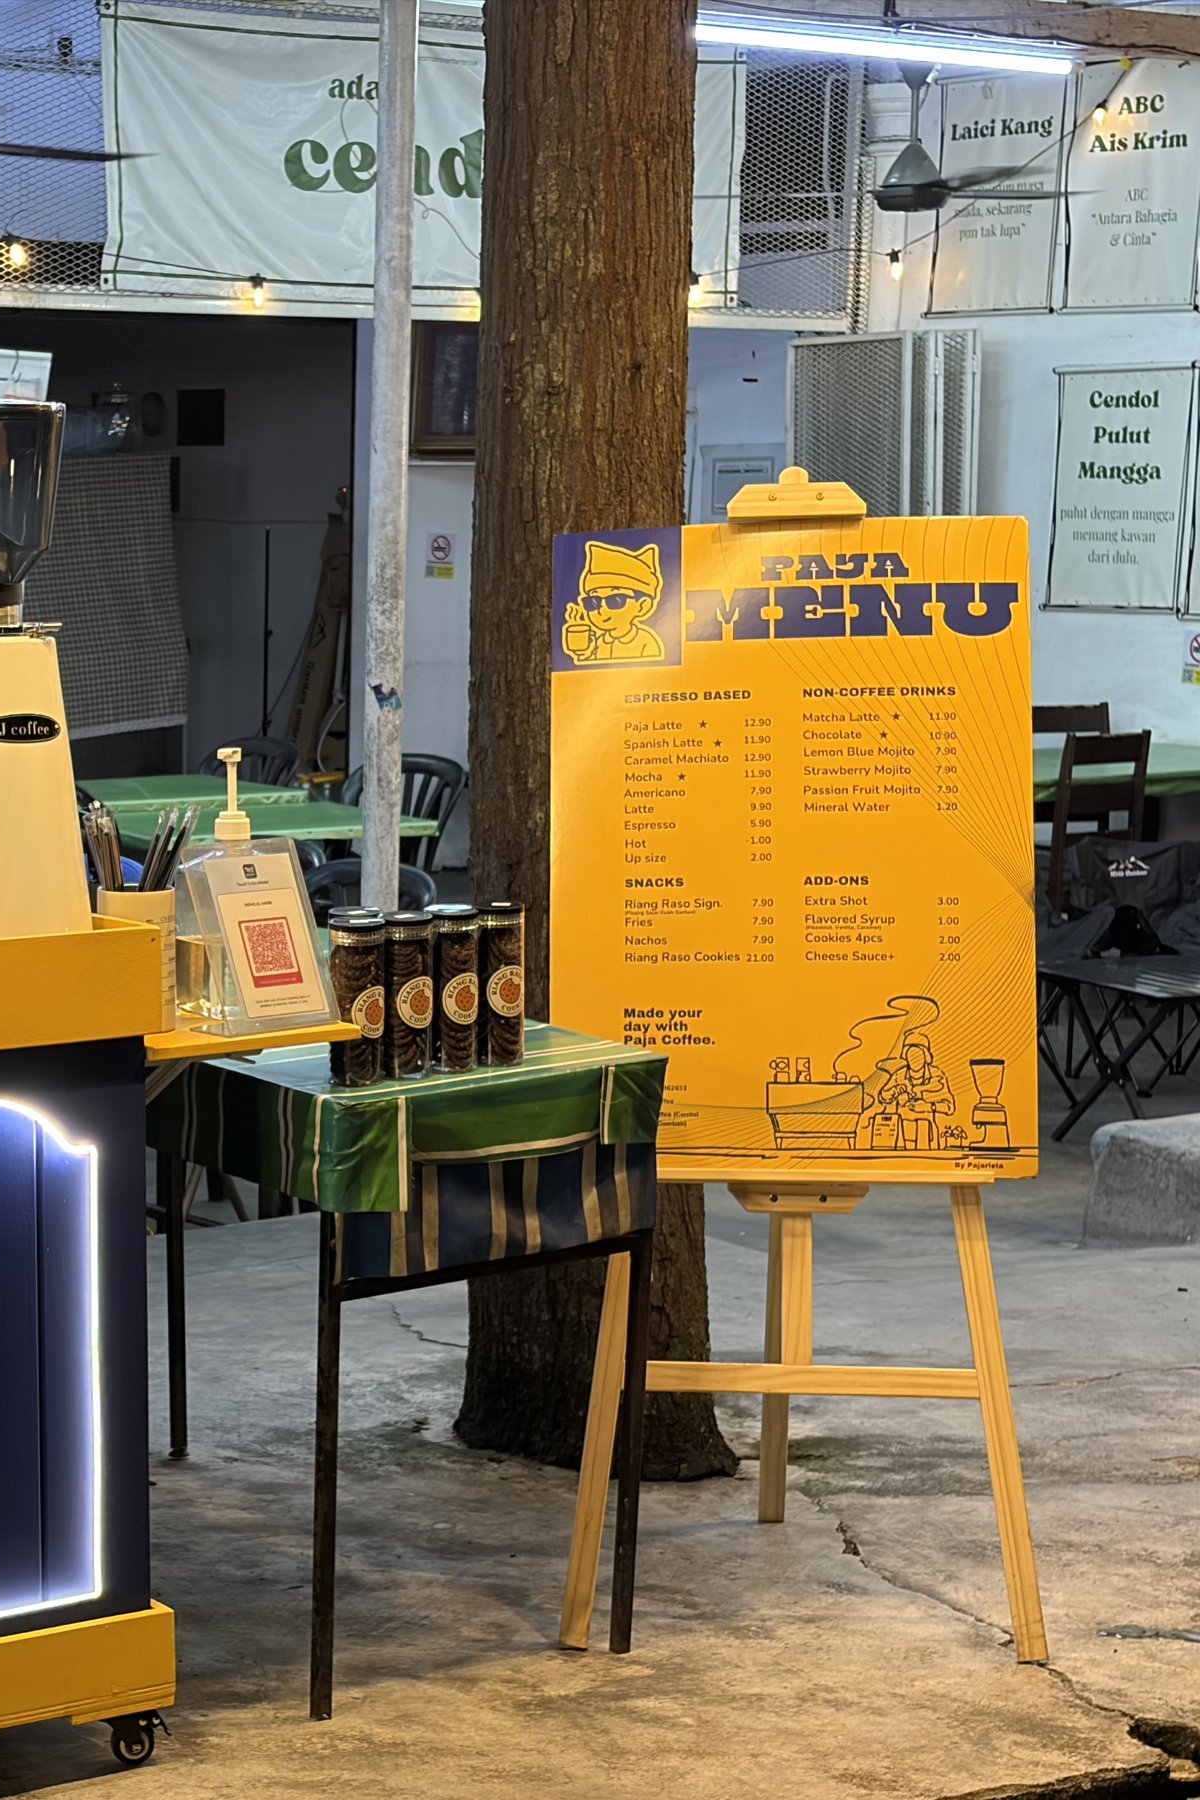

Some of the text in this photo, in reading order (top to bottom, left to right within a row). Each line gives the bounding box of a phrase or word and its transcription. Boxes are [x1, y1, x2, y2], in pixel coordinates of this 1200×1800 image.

[1118, 94, 1164, 115] ABC
[951, 115, 1053, 141] Laici Kang
[1089, 129, 1188, 152] Ais Krim
[1124, 188, 1148, 202] ABC
[985, 202, 1033, 217] sekarang
[1135, 208, 1178, 225] Bahagia
[959, 229, 978, 241] pun
[981, 225, 998, 238] tak
[1110, 233, 1121, 246] &
[1089, 390, 1160, 409] Cendol
[1093, 426, 1151, 445] Pulut
[1078, 461, 1162, 485] Mangga
[1060, 506, 1175, 523] pulut dengan mangga
[1072, 529, 1155, 544] memang kawan
[1088, 549, 1139, 565] dari dulu.
[760, 553, 910, 581] PAJA
[684, 582, 1019, 643] MENU
[625, 690, 751, 703] ESPRESSO BASED
[803, 687, 956, 697] NON-COFFEE DRINKS
[803, 712, 956, 722] Matcha Latte 11.90
[11, 721, 50, 736] coffee
[625, 719, 771, 733] Paja Latte 12.90
[803, 730, 957, 740] Chocolate 10.90
[624, 736, 771, 750] Spanish Latte 11.90
[804, 747, 956, 758] Lemon Blue Mojito 7.90
[625, 753, 771, 765] Caramel Machiato 12.90
[625, 770, 771, 782] Mocha 11.90
[804, 765, 957, 776] Strawberry Mojito 7.90
[624, 788, 685, 798] Americano
[804, 785, 958, 796] Passion Fruit Mojito 7.90
[625, 805, 654, 814] Latte
[805, 803, 957, 812] Mineral Water 1.20
[624, 819, 771, 831] Espresso 5.90
[625, 839, 646, 848] Hot
[625, 853, 772, 864] Up size 2.00
[625, 878, 684, 888] SNACKS
[804, 876, 869, 885] ADD-ONS
[625, 898, 773, 910] Riang Raso Sign. 7.90
[805, 896, 958, 906] Extra Shot 3.00
[625, 917, 773, 927] Fries 7.90
[805, 914, 959, 926] Flavored Syrup 1.00
[625, 936, 774, 945] Nachos 7.90
[805, 933, 960, 944] Cookies 4pcs 2.00
[625, 952, 774, 964] Riang Raso Cookies 21.00
[805, 951, 848, 961] Cheese
[940, 953, 960, 961] 2.00
[447, 978, 468, 999] RIANG
[491, 972, 508, 996] RIANG
[401, 982, 421, 1005] RIANG
[357, 991, 377, 1013] RIANG
[624, 1008, 702, 1020] Made your
[624, 1021, 688, 1033] day with
[624, 1034, 715, 1047] Paja Coffee.
